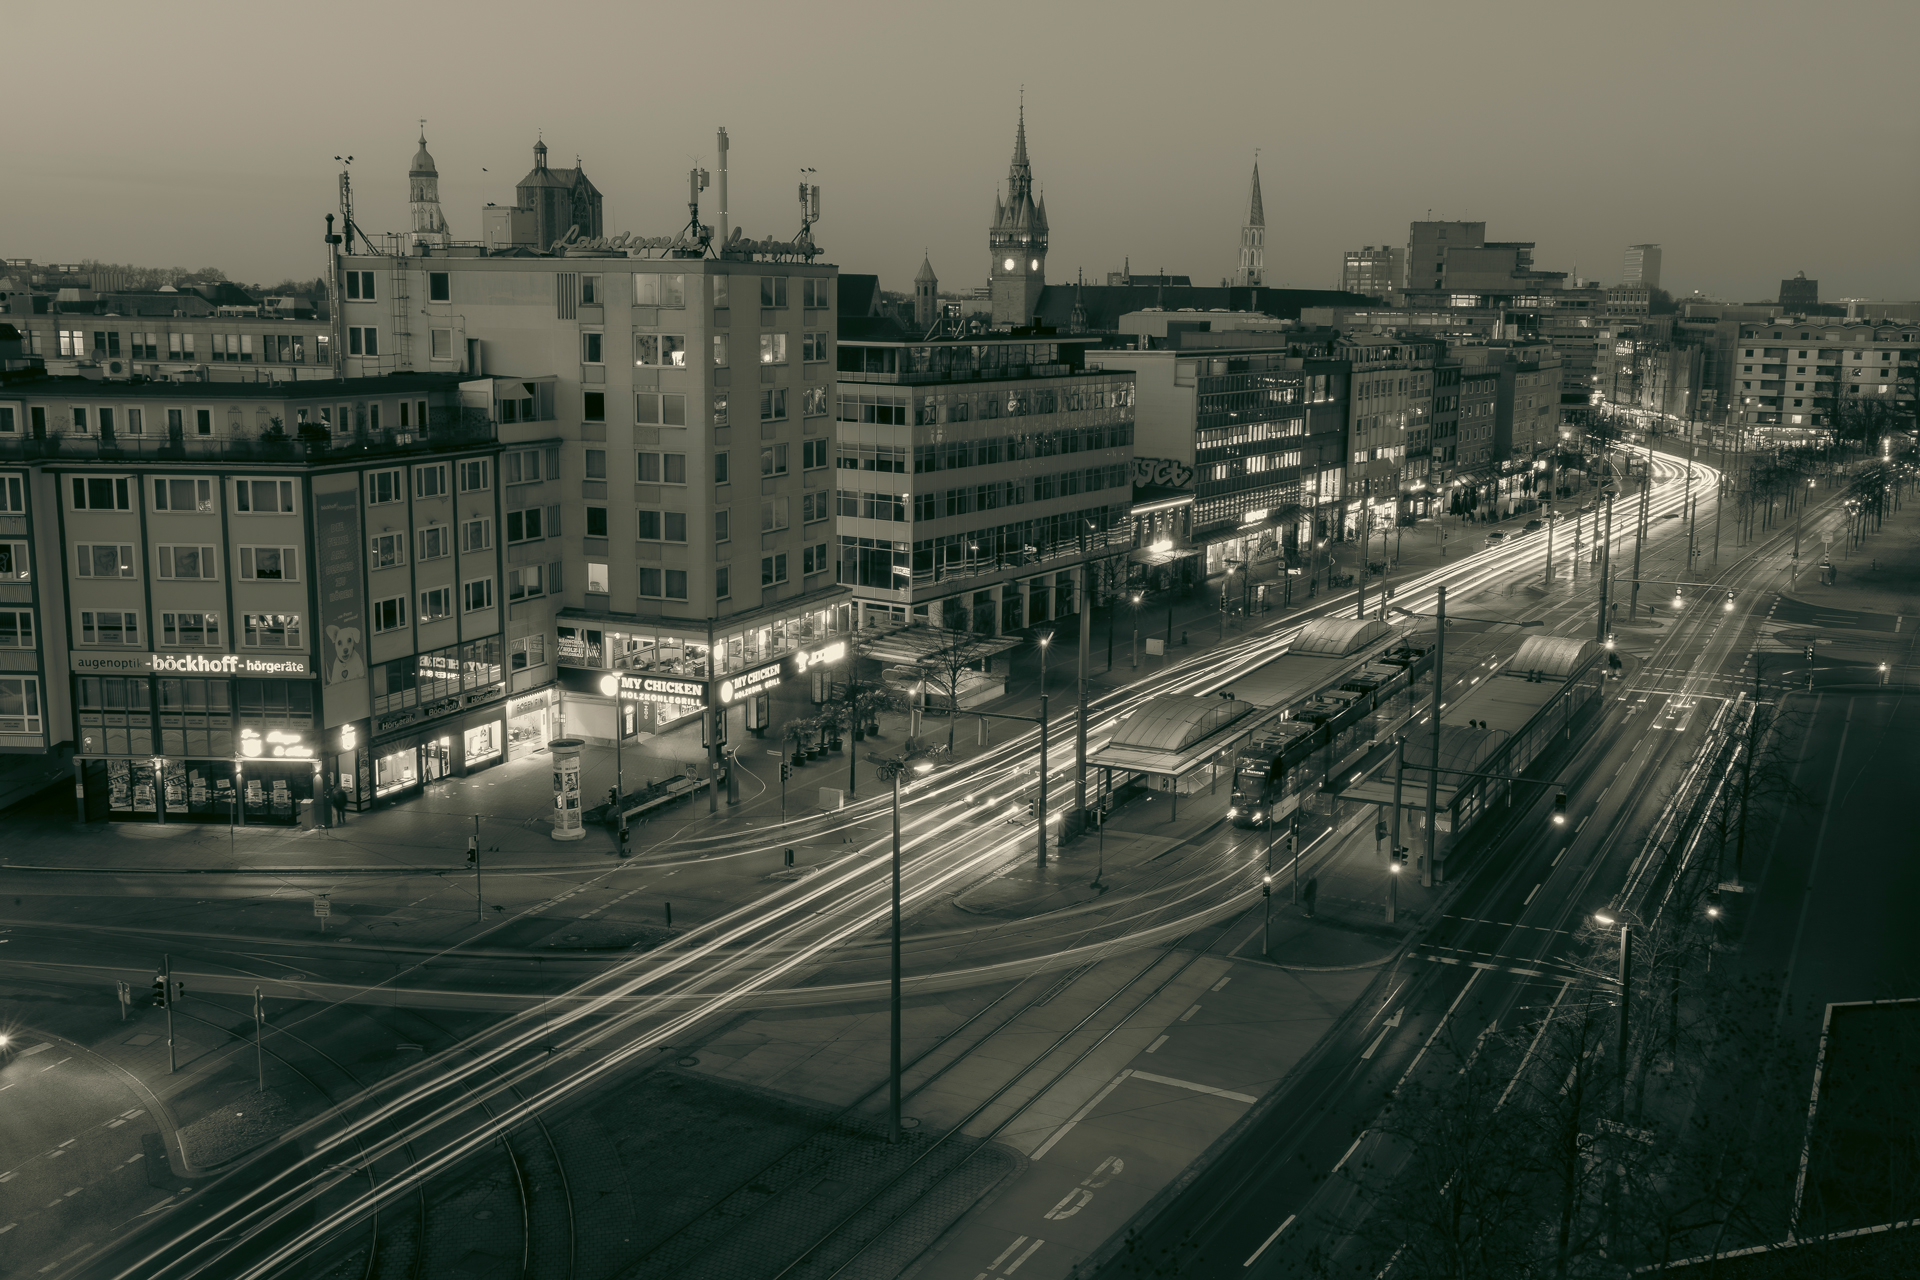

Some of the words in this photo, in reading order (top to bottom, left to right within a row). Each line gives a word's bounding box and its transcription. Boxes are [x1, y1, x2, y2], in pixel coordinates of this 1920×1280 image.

[78, 658, 143, 669] augenoptik
[152, 654, 239, 672] böckhoff
[246, 659, 304, 674] hörgeräte
[621, 676, 642, 689] MY
[644, 679, 703, 696] CHICKEN
[734, 674, 747, 689] MY
[747, 663, 781, 685] CHICKEN
[621, 691, 702, 706] HOLZKOHLEGRILL
